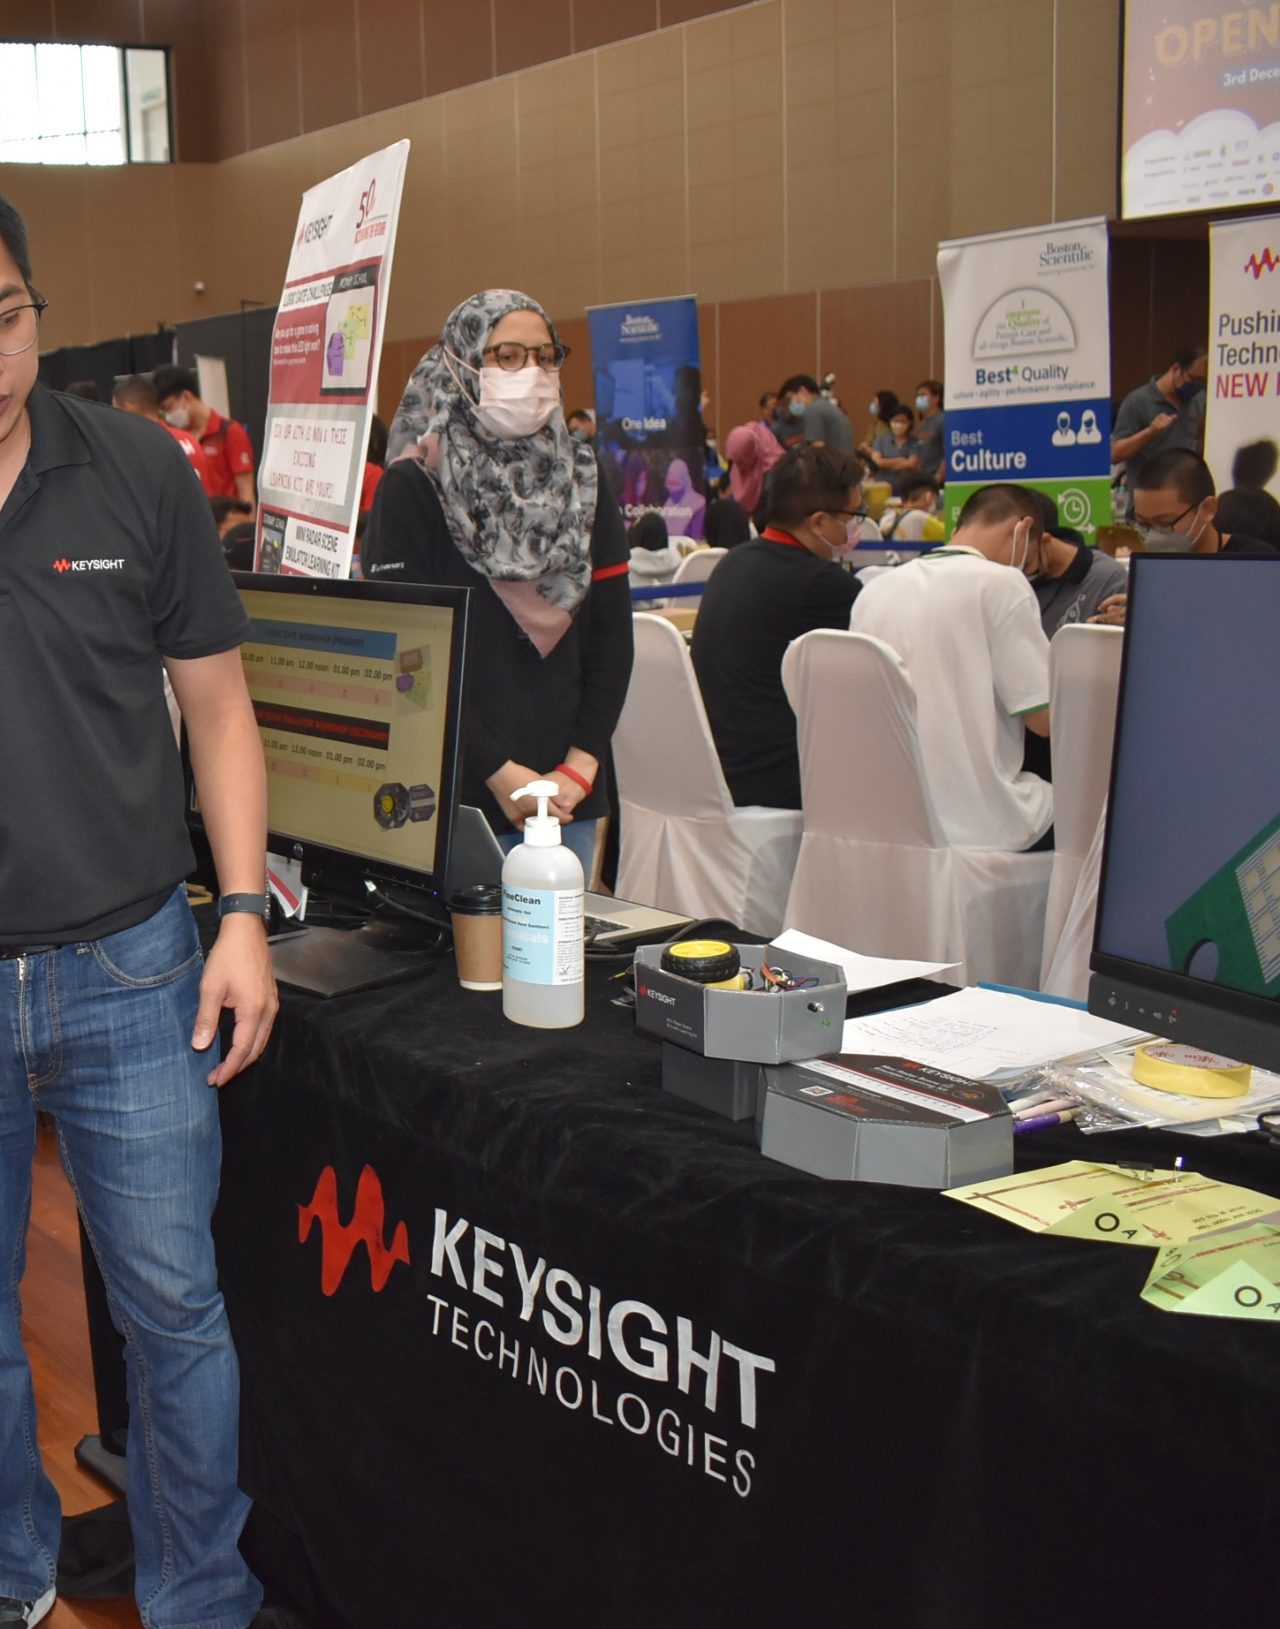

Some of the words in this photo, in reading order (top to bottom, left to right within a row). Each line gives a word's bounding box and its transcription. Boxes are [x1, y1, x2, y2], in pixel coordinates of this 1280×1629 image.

[1223, 69, 1246, 87] 3rd
[1046, 241, 1081, 254] Boston
[1039, 249, 1093, 267] Scientific
[1217, 342, 1280, 367] Techn
[1021, 363, 1069, 383] Quality
[1215, 372, 1269, 399] NEW
[621, 417, 641, 431] One
[642, 416, 666, 430] Idea
[951, 429, 984, 447] Best
[951, 448, 1027, 473] Culture
[71, 559, 125, 571] KEYSIGHT
[919, 1066, 979, 1087] KEYSIGHT
[430, 1207, 776, 1430] KEYSIGHT
[427, 1294, 756, 1498] TECHNOLOGIES
